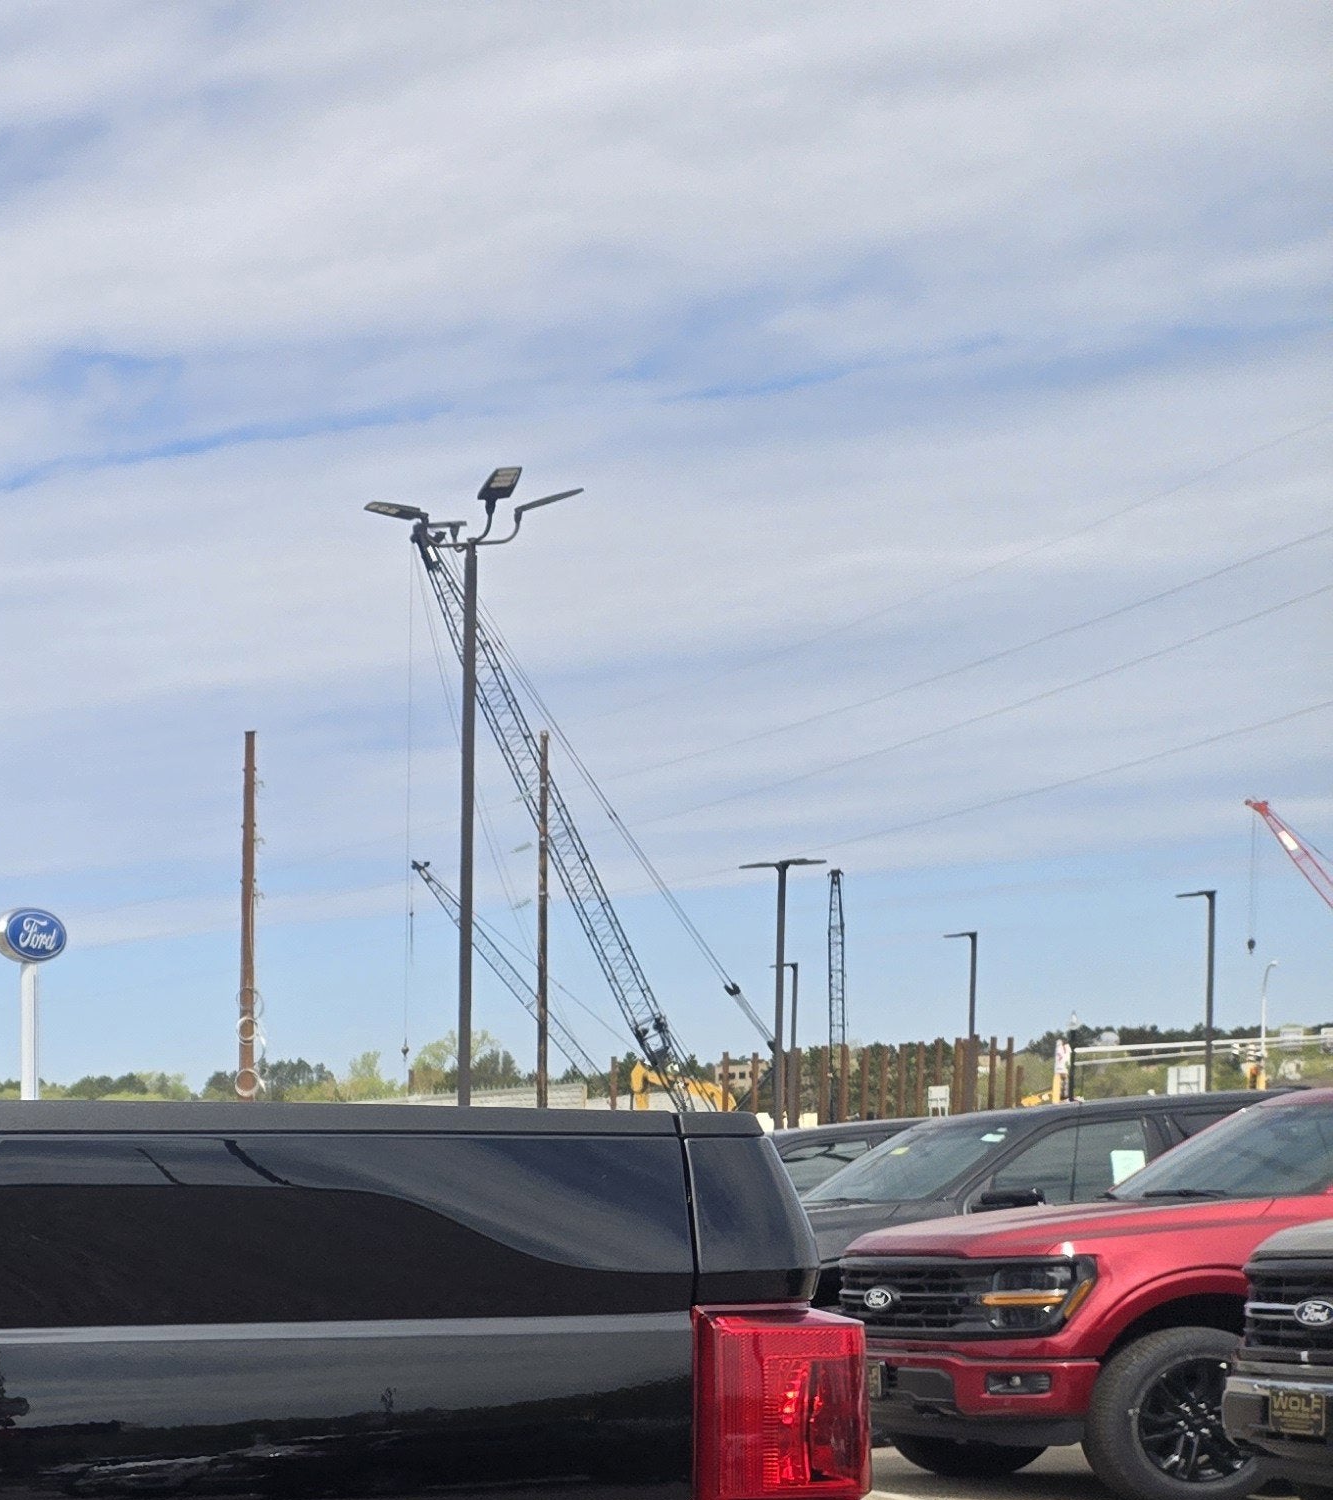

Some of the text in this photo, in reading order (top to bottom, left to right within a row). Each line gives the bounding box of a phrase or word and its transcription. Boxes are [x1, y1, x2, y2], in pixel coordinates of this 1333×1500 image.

[19, 917, 57, 950] Ford
[1302, 1303, 1329, 1321] Ford
[1273, 1396, 1321, 1412] WOLF
